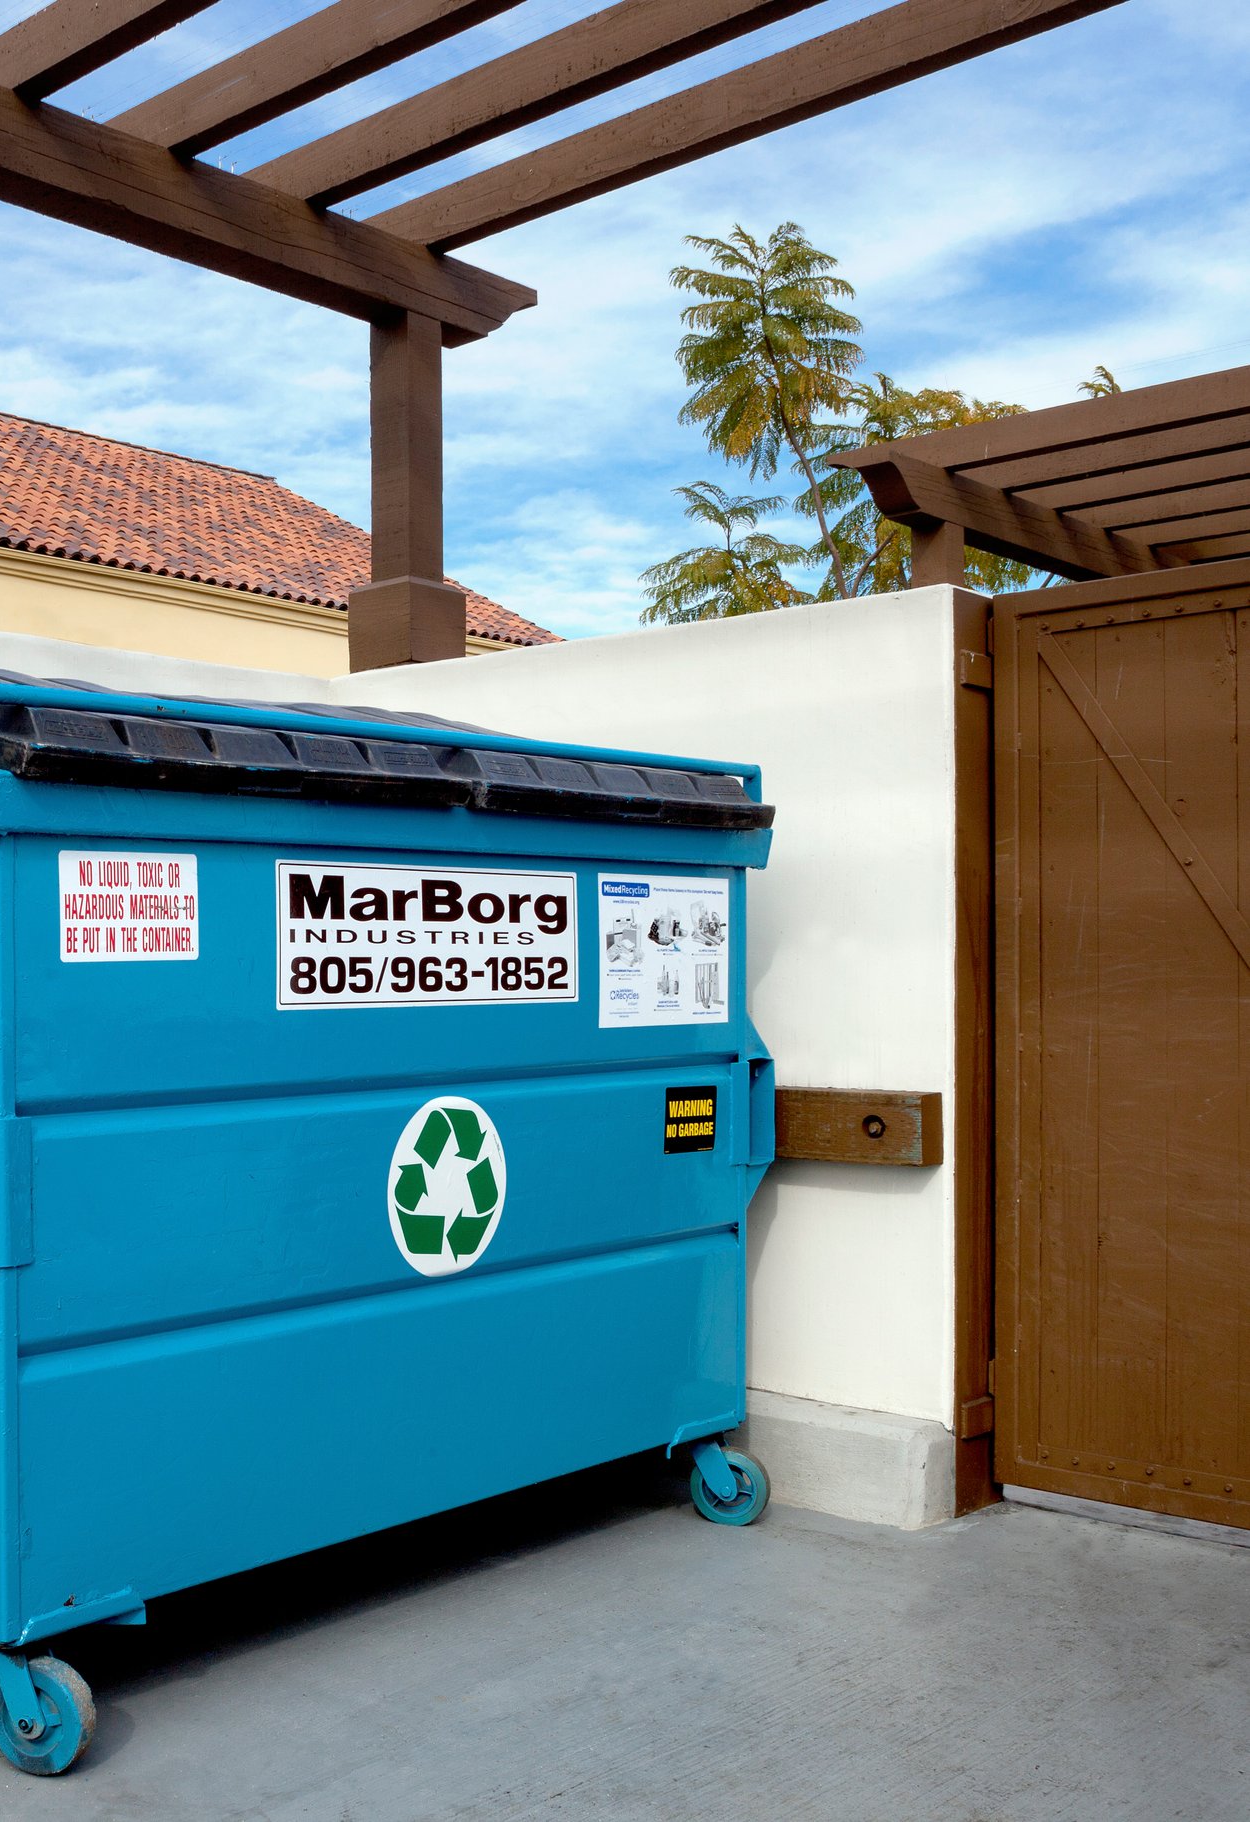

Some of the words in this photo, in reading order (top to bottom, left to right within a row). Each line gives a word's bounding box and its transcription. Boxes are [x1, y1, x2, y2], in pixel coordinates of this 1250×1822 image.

[79, 861, 93, 887] NO
[98, 861, 133, 890] LIQUID,
[137, 862, 163, 888] TOXIC
[168, 863, 181, 888] OR
[64, 894, 124, 920] HAZARDOUS
[129, 894, 179, 920] MATERIALS
[184, 895, 195, 920] TO
[288, 873, 568, 935] MarBorg
[66, 927, 78, 953] BE
[83, 927, 100, 953] PUT
[106, 927, 116, 952] IN
[121, 927, 137, 952] THE
[142, 927, 194, 952] CONTAINER.
[289, 929, 535, 945] INDUSTRIES
[289, 956, 568, 994] 805/963-1852
[669, 1099, 713, 1118] WARNING
[666, 1124, 677, 1138] NO
[679, 1122, 714, 1137] GARBAGE
